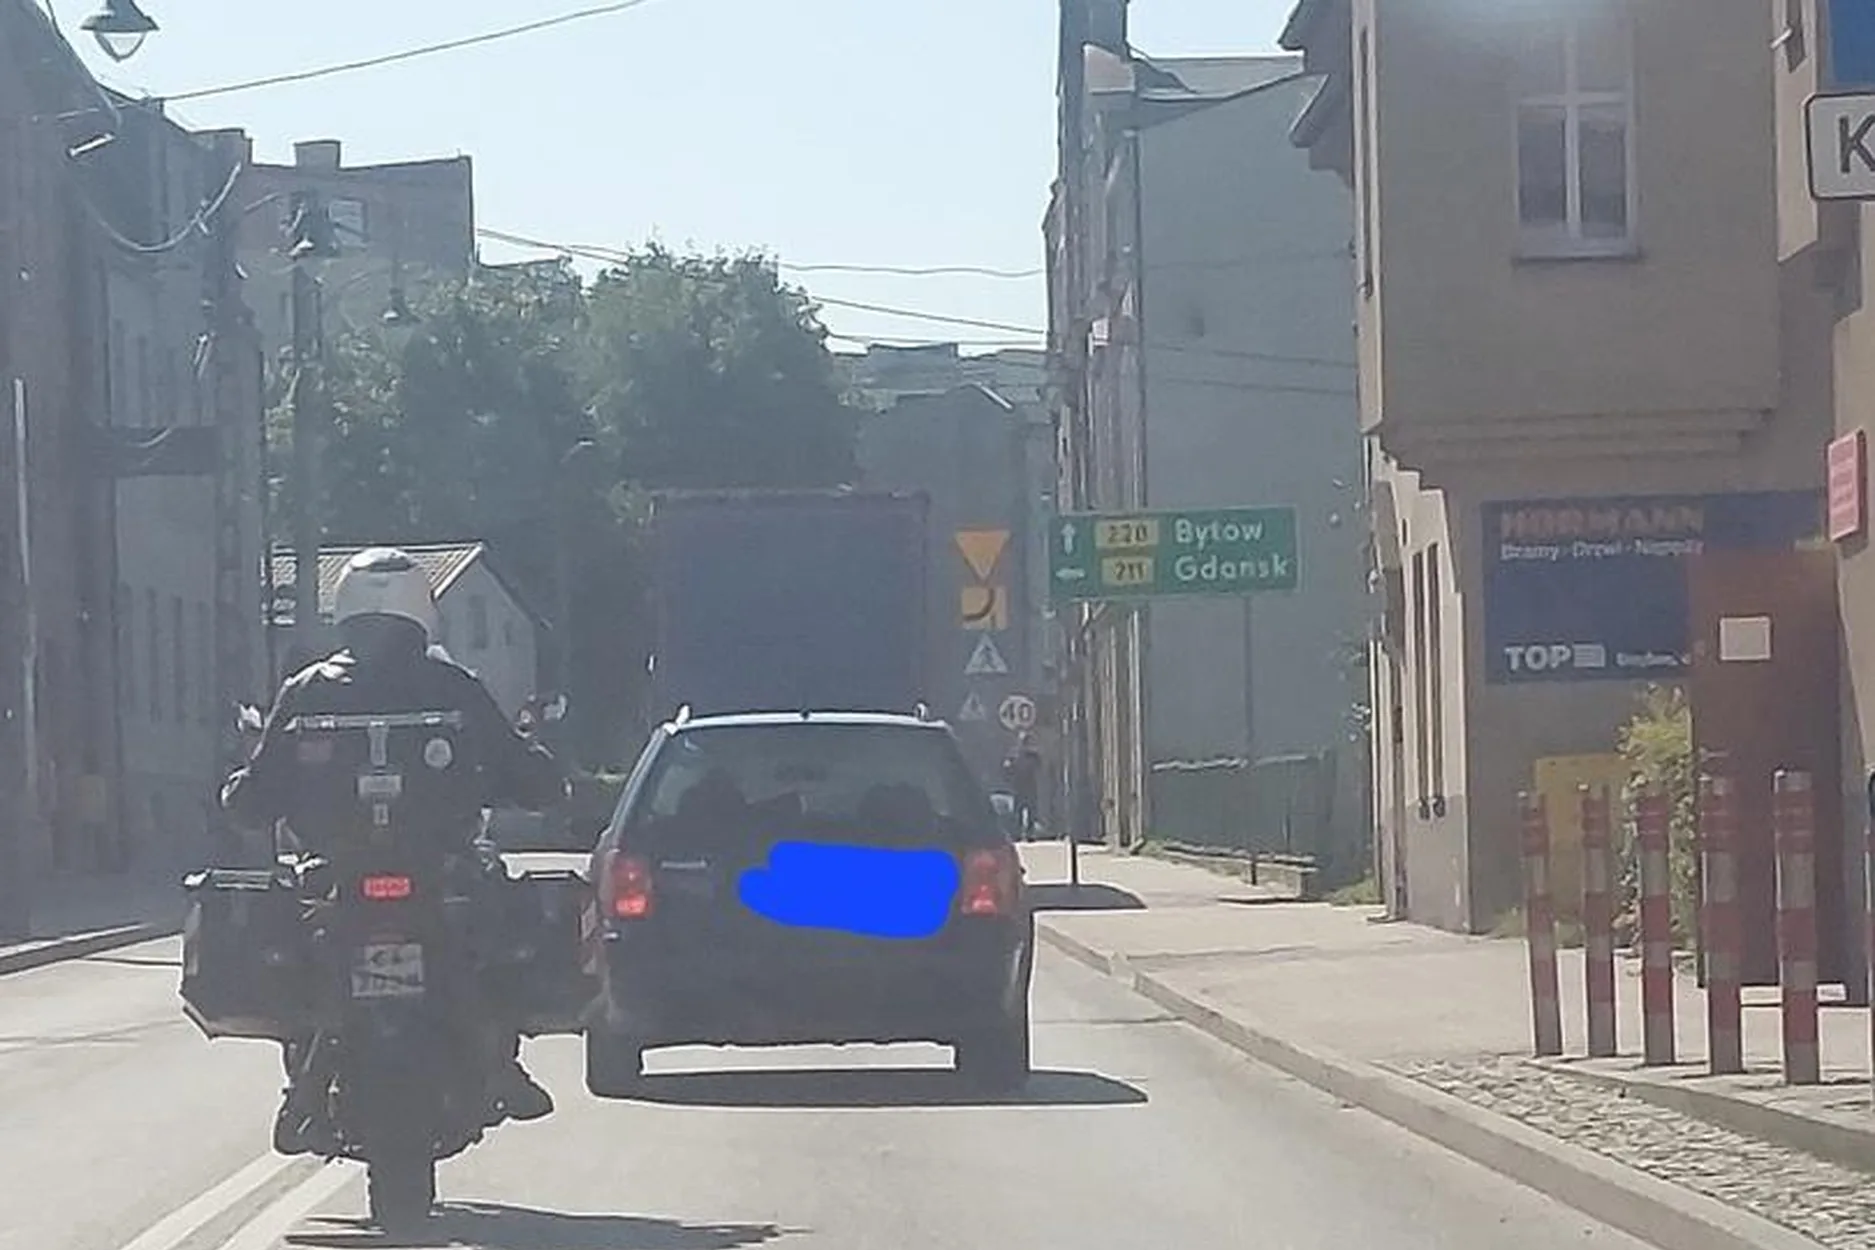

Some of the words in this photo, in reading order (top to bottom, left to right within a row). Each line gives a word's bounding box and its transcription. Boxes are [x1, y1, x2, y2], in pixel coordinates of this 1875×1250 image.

[1106, 523, 1148, 543] 220
[1114, 560, 1145, 581] 211
[1505, 644, 1572, 670] TOP
[1001, 702, 1032, 722] 40
